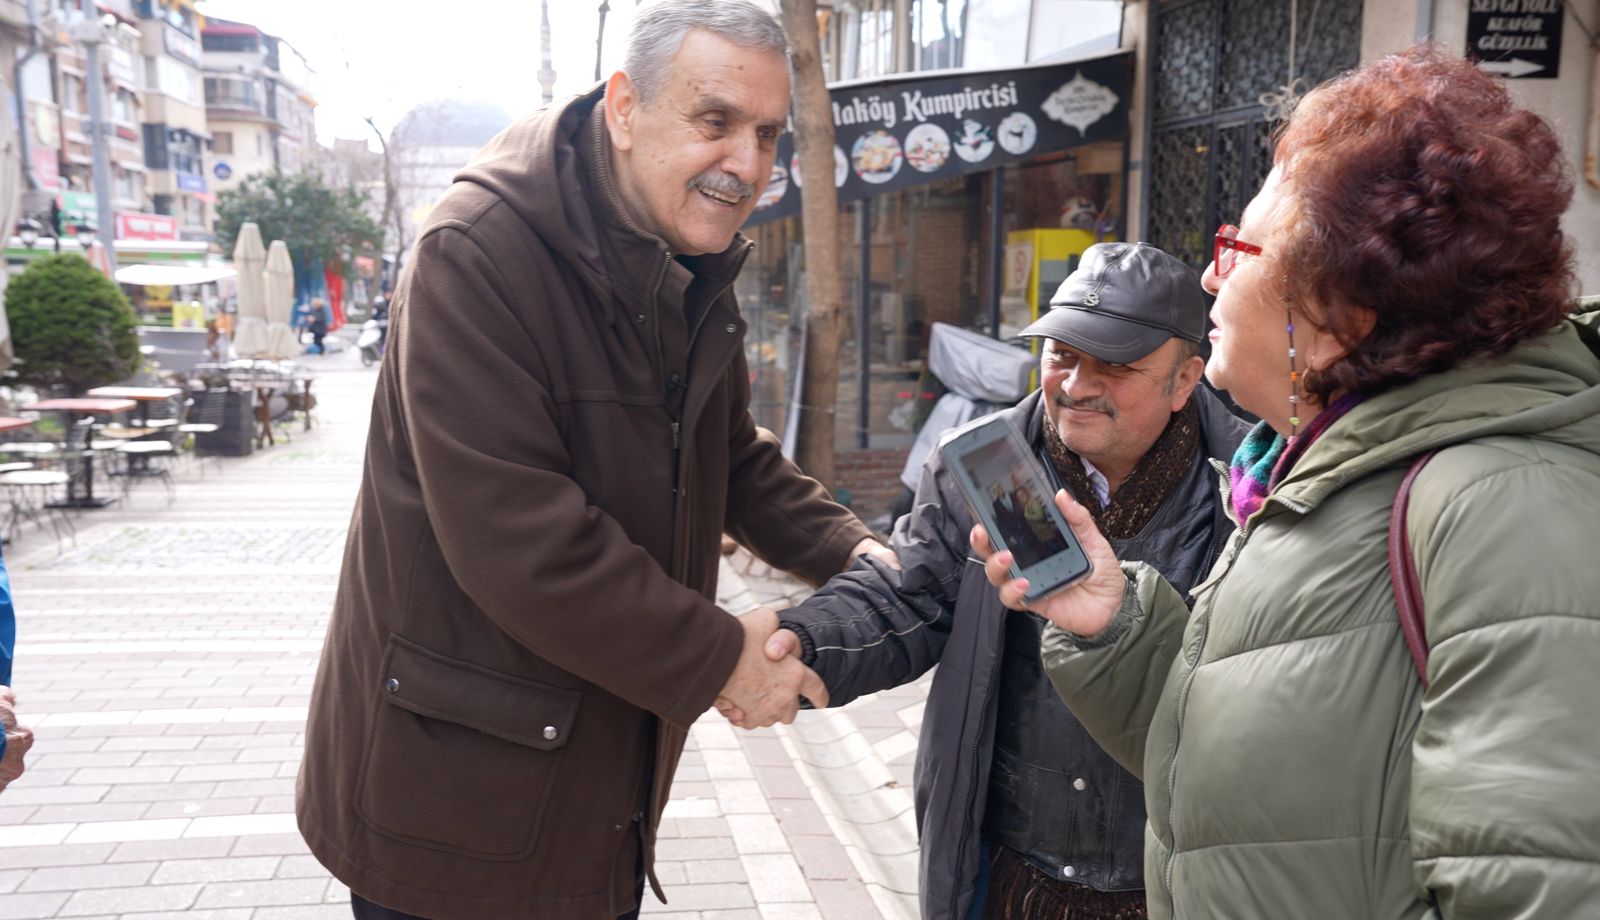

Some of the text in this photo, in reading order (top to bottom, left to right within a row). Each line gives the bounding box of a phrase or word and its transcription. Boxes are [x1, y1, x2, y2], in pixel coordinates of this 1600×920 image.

[1486, 14, 1544, 32] KUAFÖR
[831, 96, 896, 129] taköy
[901, 80, 1018, 122] Kumpircisi
